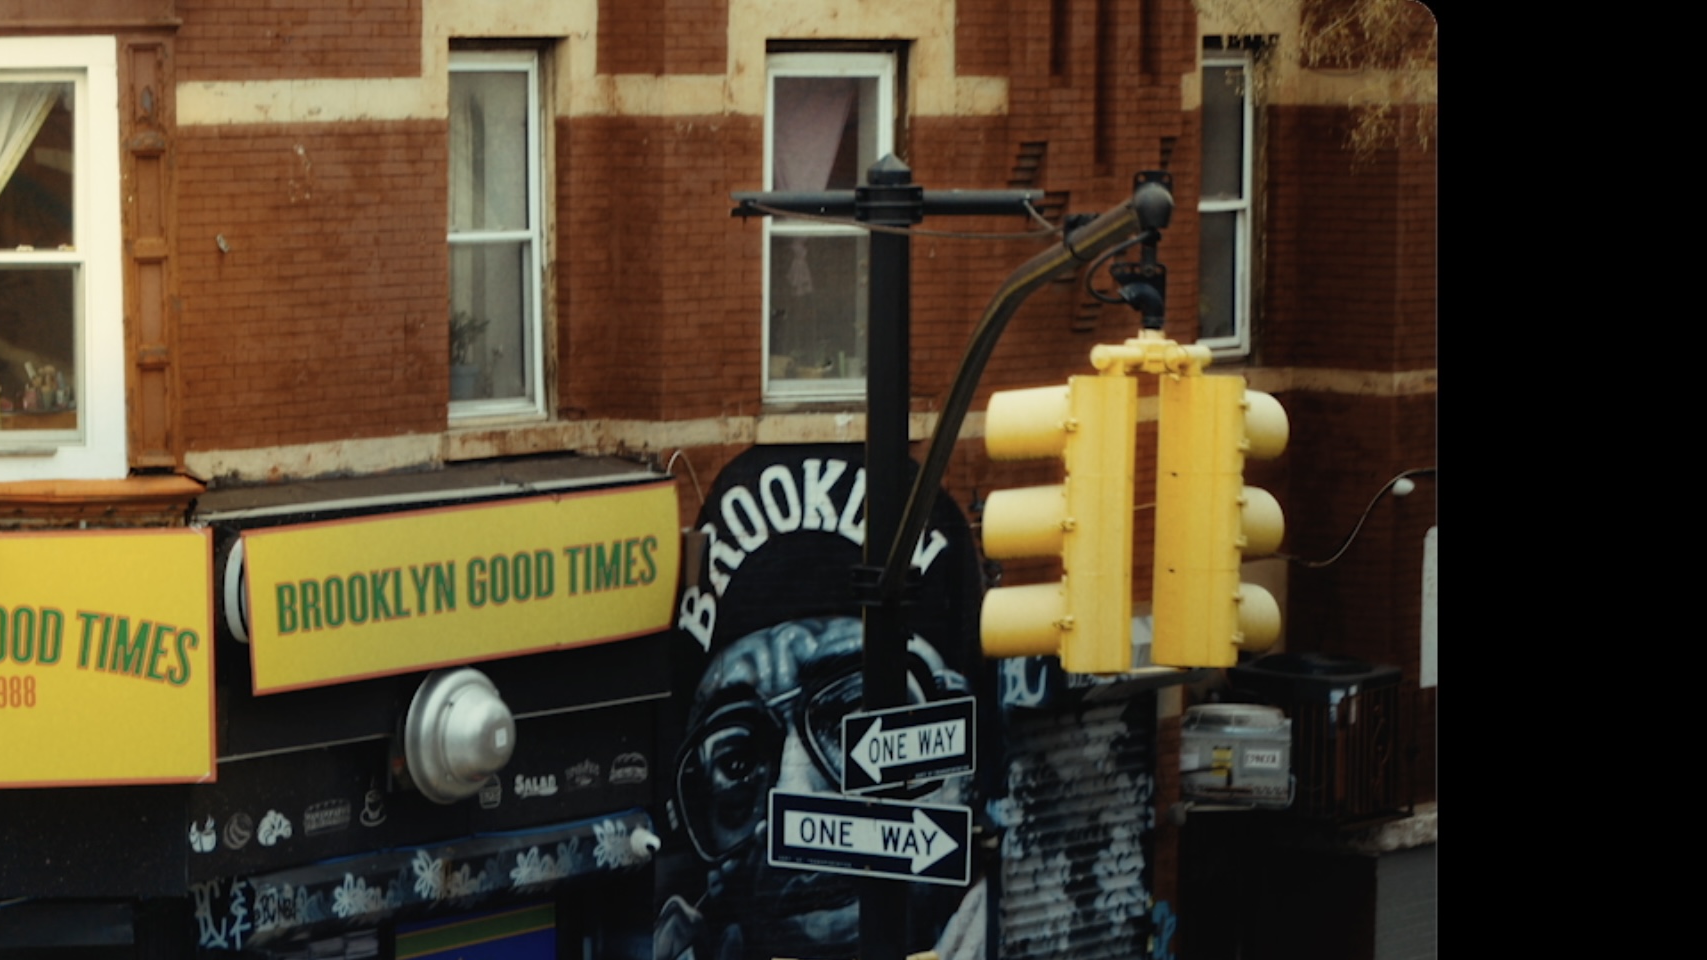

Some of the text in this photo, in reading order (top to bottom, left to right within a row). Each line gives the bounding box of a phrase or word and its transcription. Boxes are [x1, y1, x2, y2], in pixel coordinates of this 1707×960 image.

[275, 535, 659, 637] BROOKLYN GOOD TIMES
[678, 458, 949, 653] BROOKLN
[75, 610, 200, 688] TIMES
[868, 724, 959, 765] ONE WAY
[800, 817, 939, 856] ONE WAY
